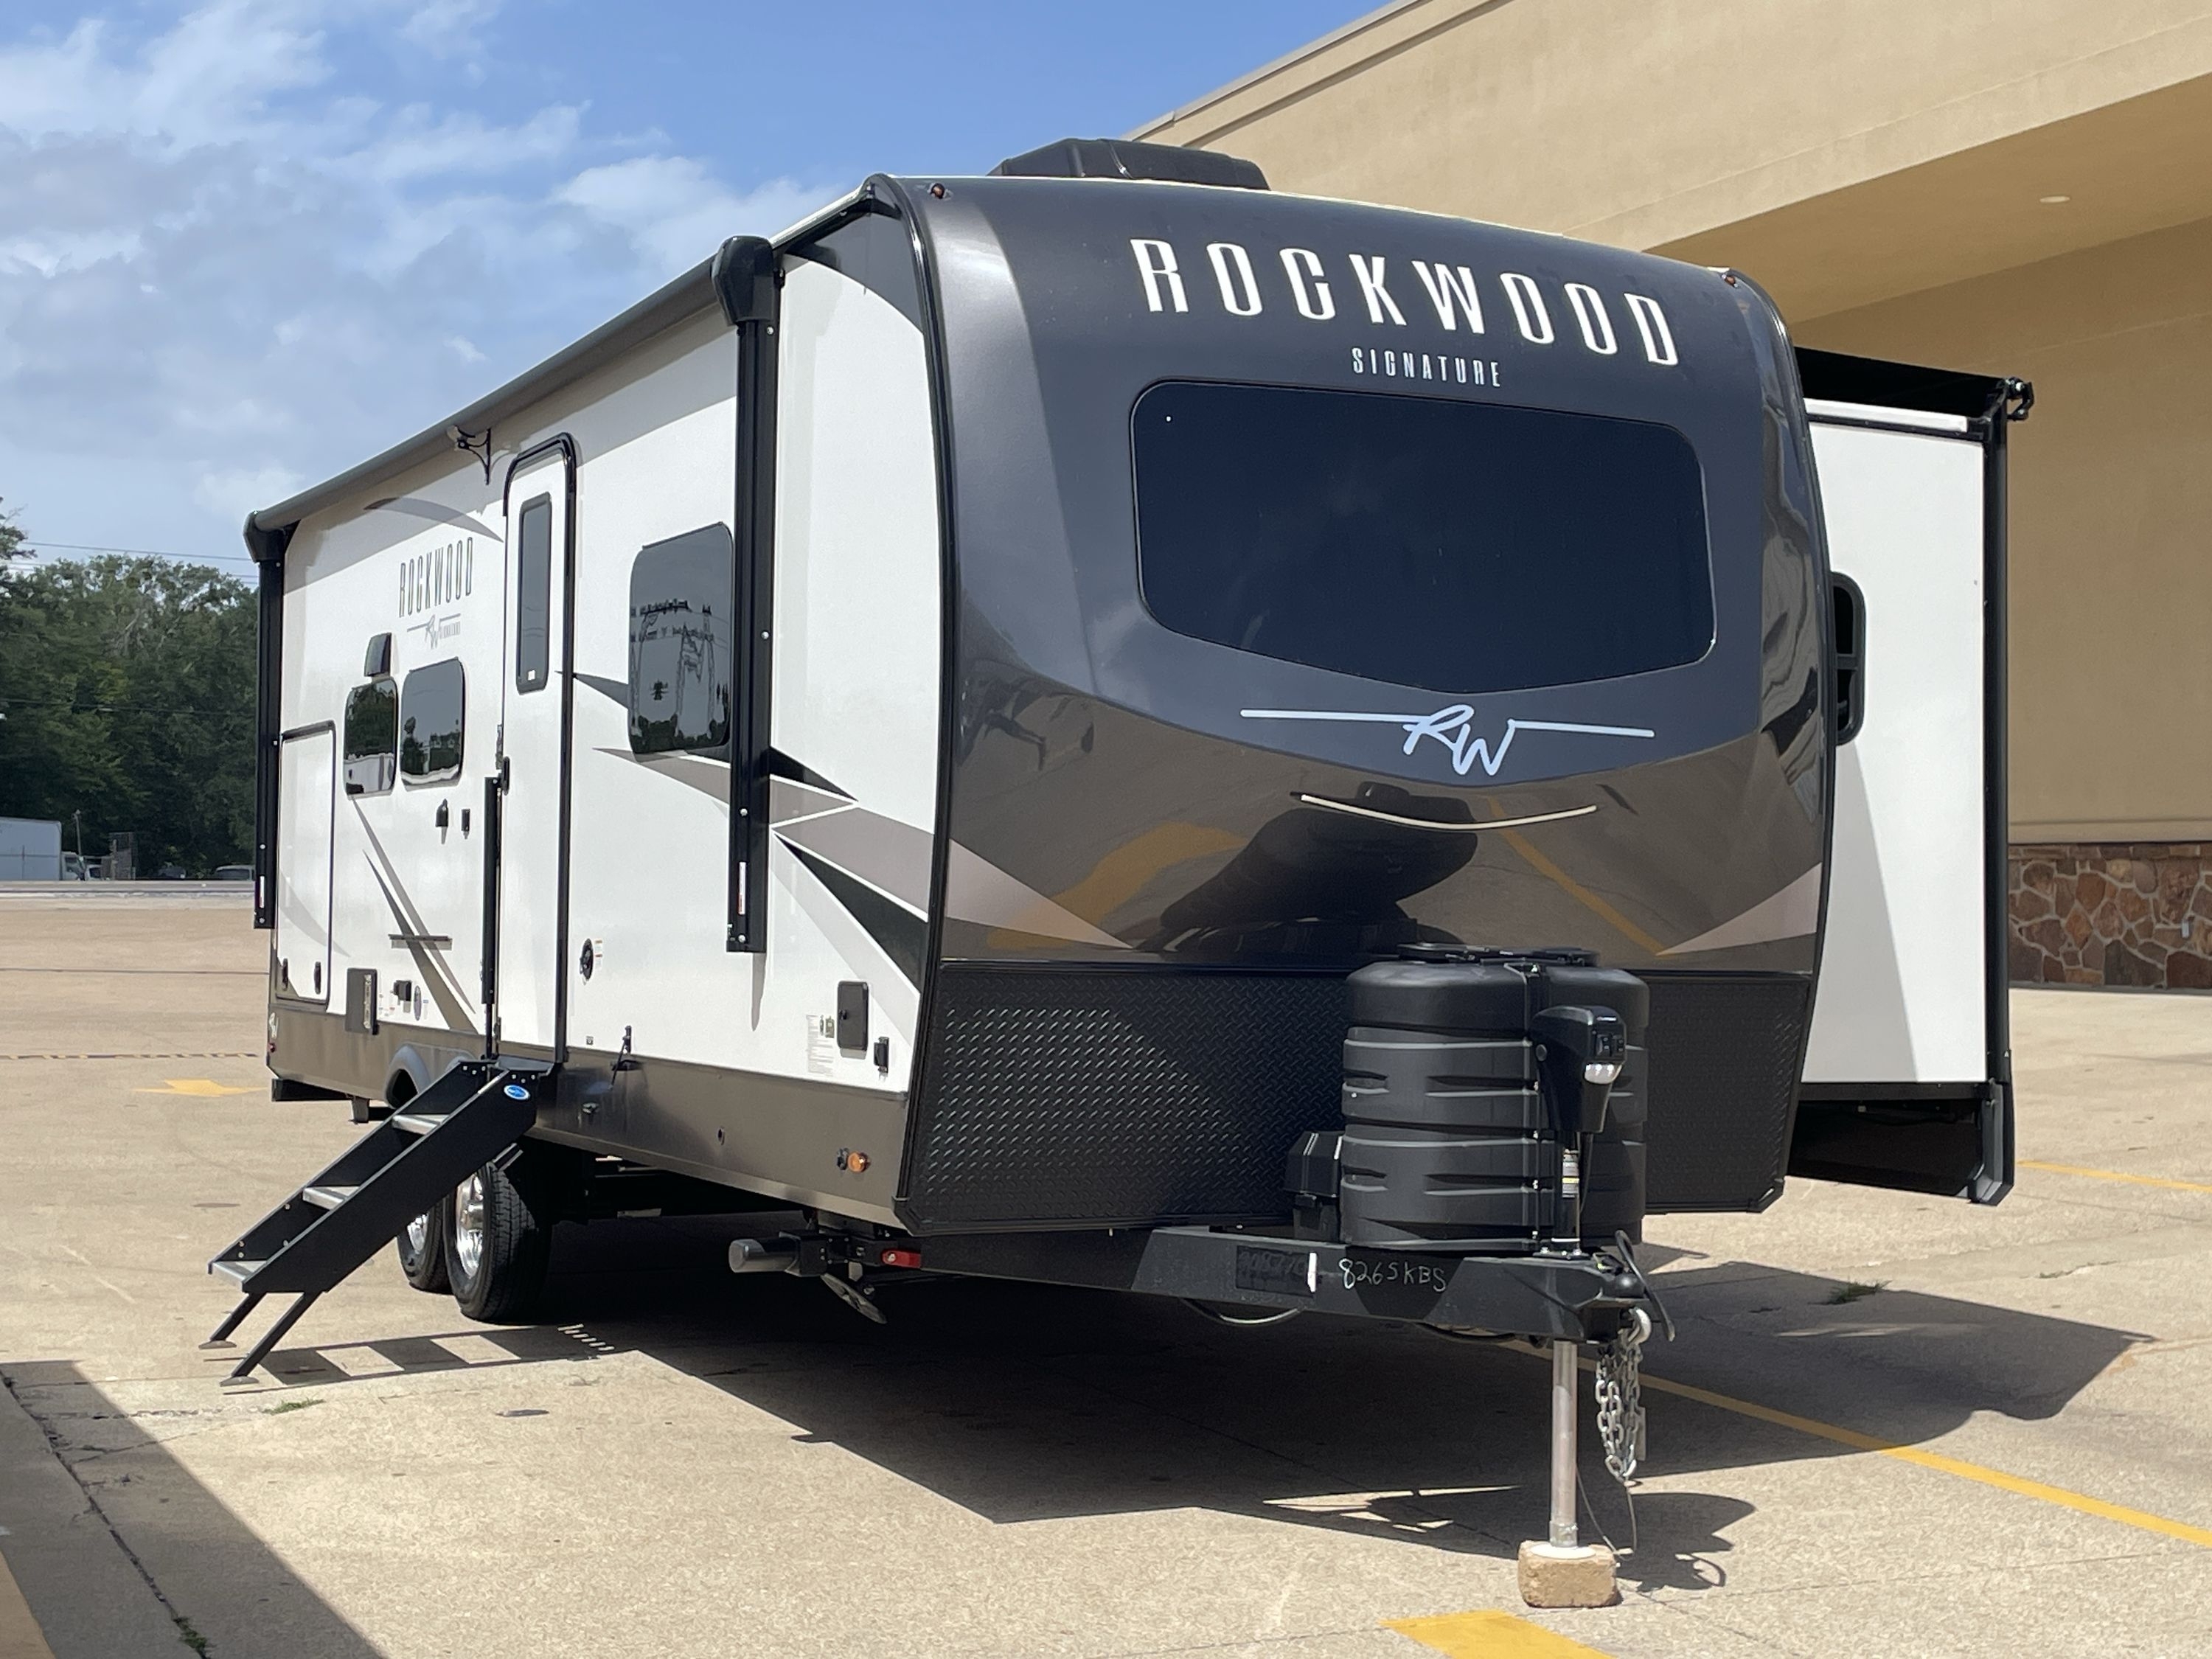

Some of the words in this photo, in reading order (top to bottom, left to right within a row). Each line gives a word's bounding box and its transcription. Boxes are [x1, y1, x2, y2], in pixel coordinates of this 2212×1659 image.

[1130, 238, 1679, 366] ROCKWOOD
[1351, 347, 1501, 388] SIGNATURE
[398, 536, 473, 619] ROCKWOOD
[1402, 703, 1517, 776] RW
